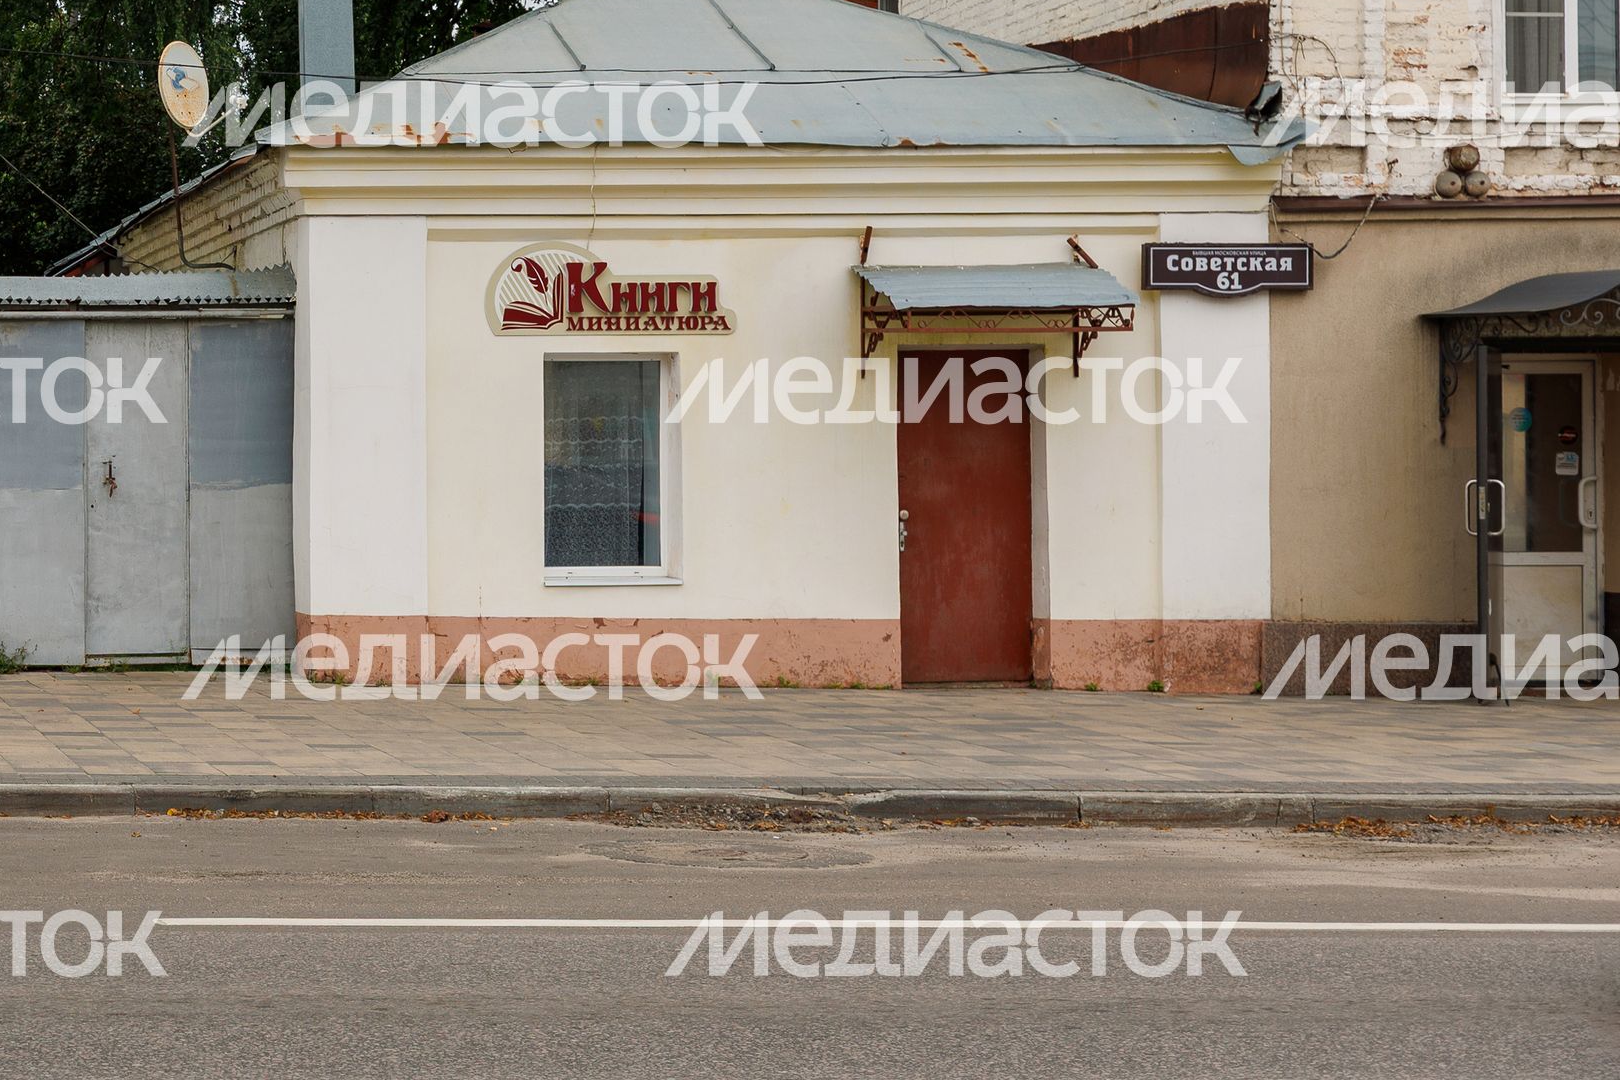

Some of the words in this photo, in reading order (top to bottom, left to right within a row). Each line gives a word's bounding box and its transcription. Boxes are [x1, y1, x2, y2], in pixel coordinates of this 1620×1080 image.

[1166, 254, 1293, 272] Советская
[565, 261, 719, 314] Книги
[1216, 272, 1243, 290] 61
[565, 315, 732, 332] МИНИАТЮРА
